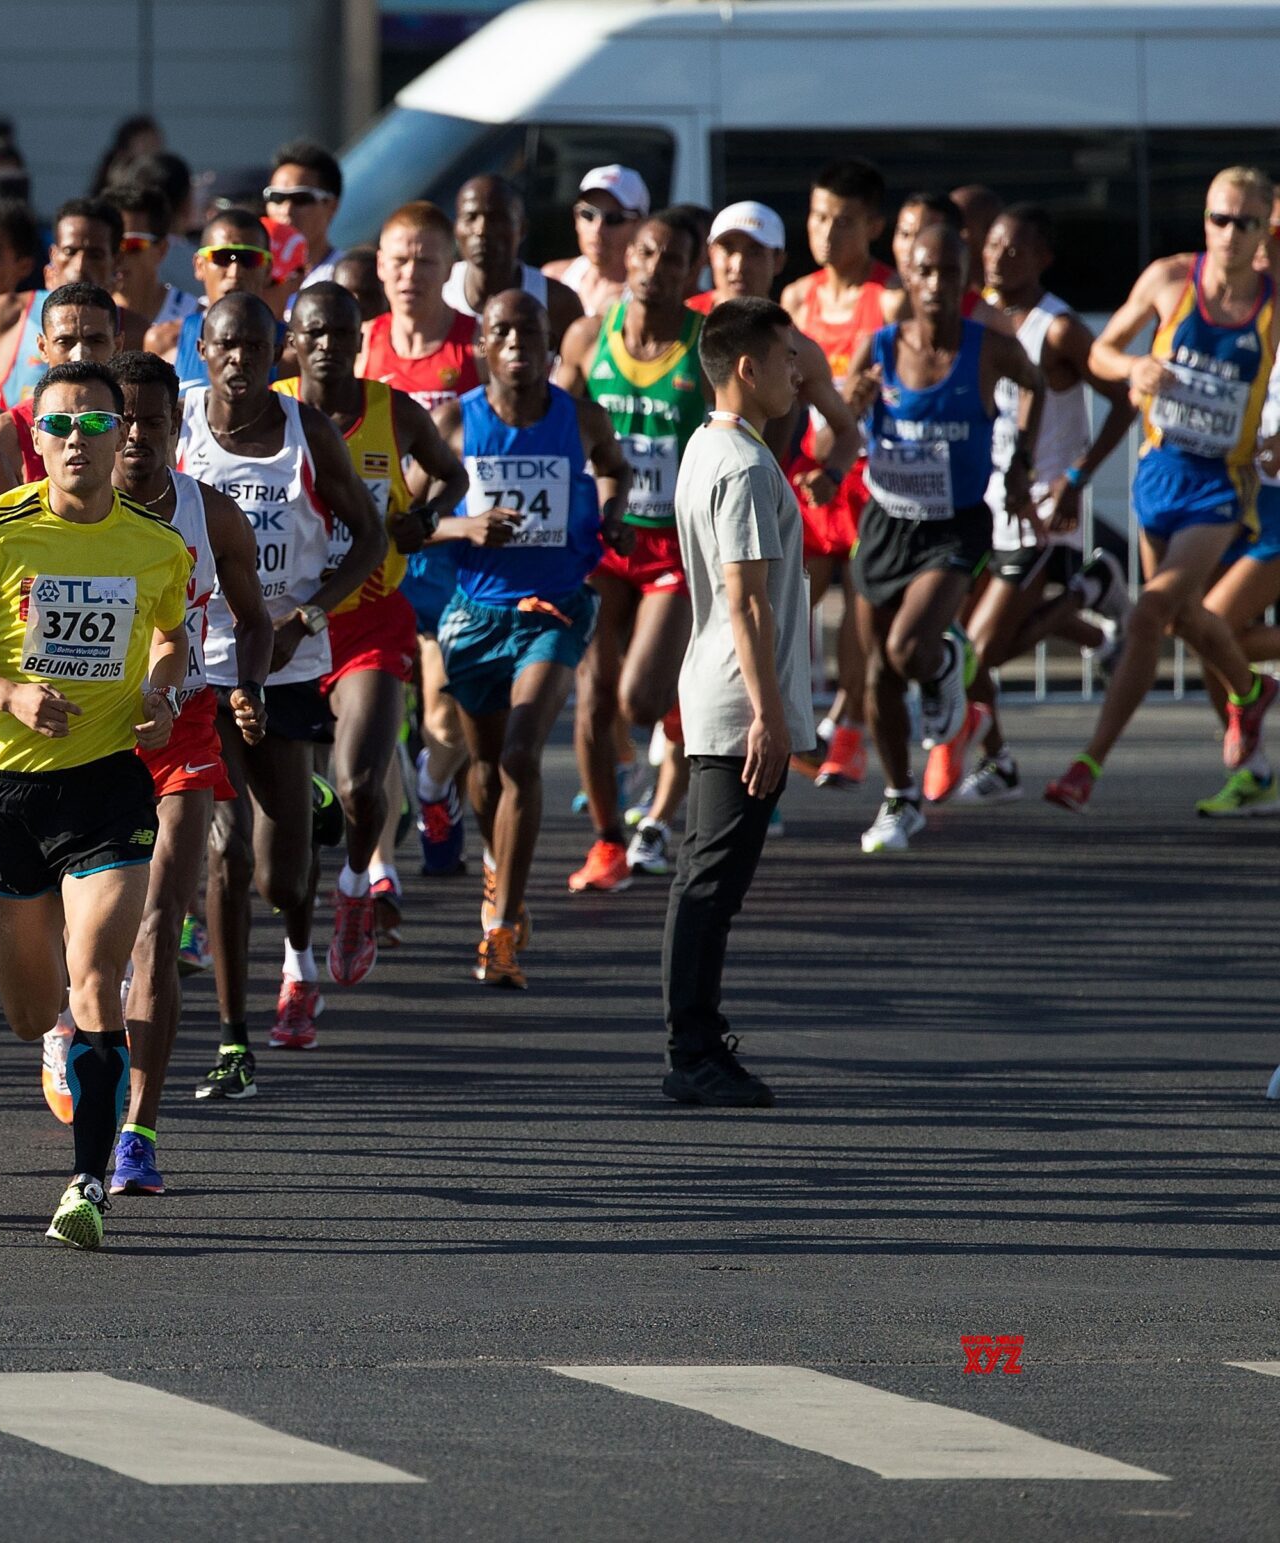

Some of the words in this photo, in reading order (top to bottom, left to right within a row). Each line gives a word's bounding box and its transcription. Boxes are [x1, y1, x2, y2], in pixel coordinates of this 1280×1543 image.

[494, 460, 560, 480] TDK
[484, 489, 552, 520] 724
[43, 610, 116, 643] 3762
[23, 656, 90, 677] BEIJING
[91, 661, 123, 678] 2015
